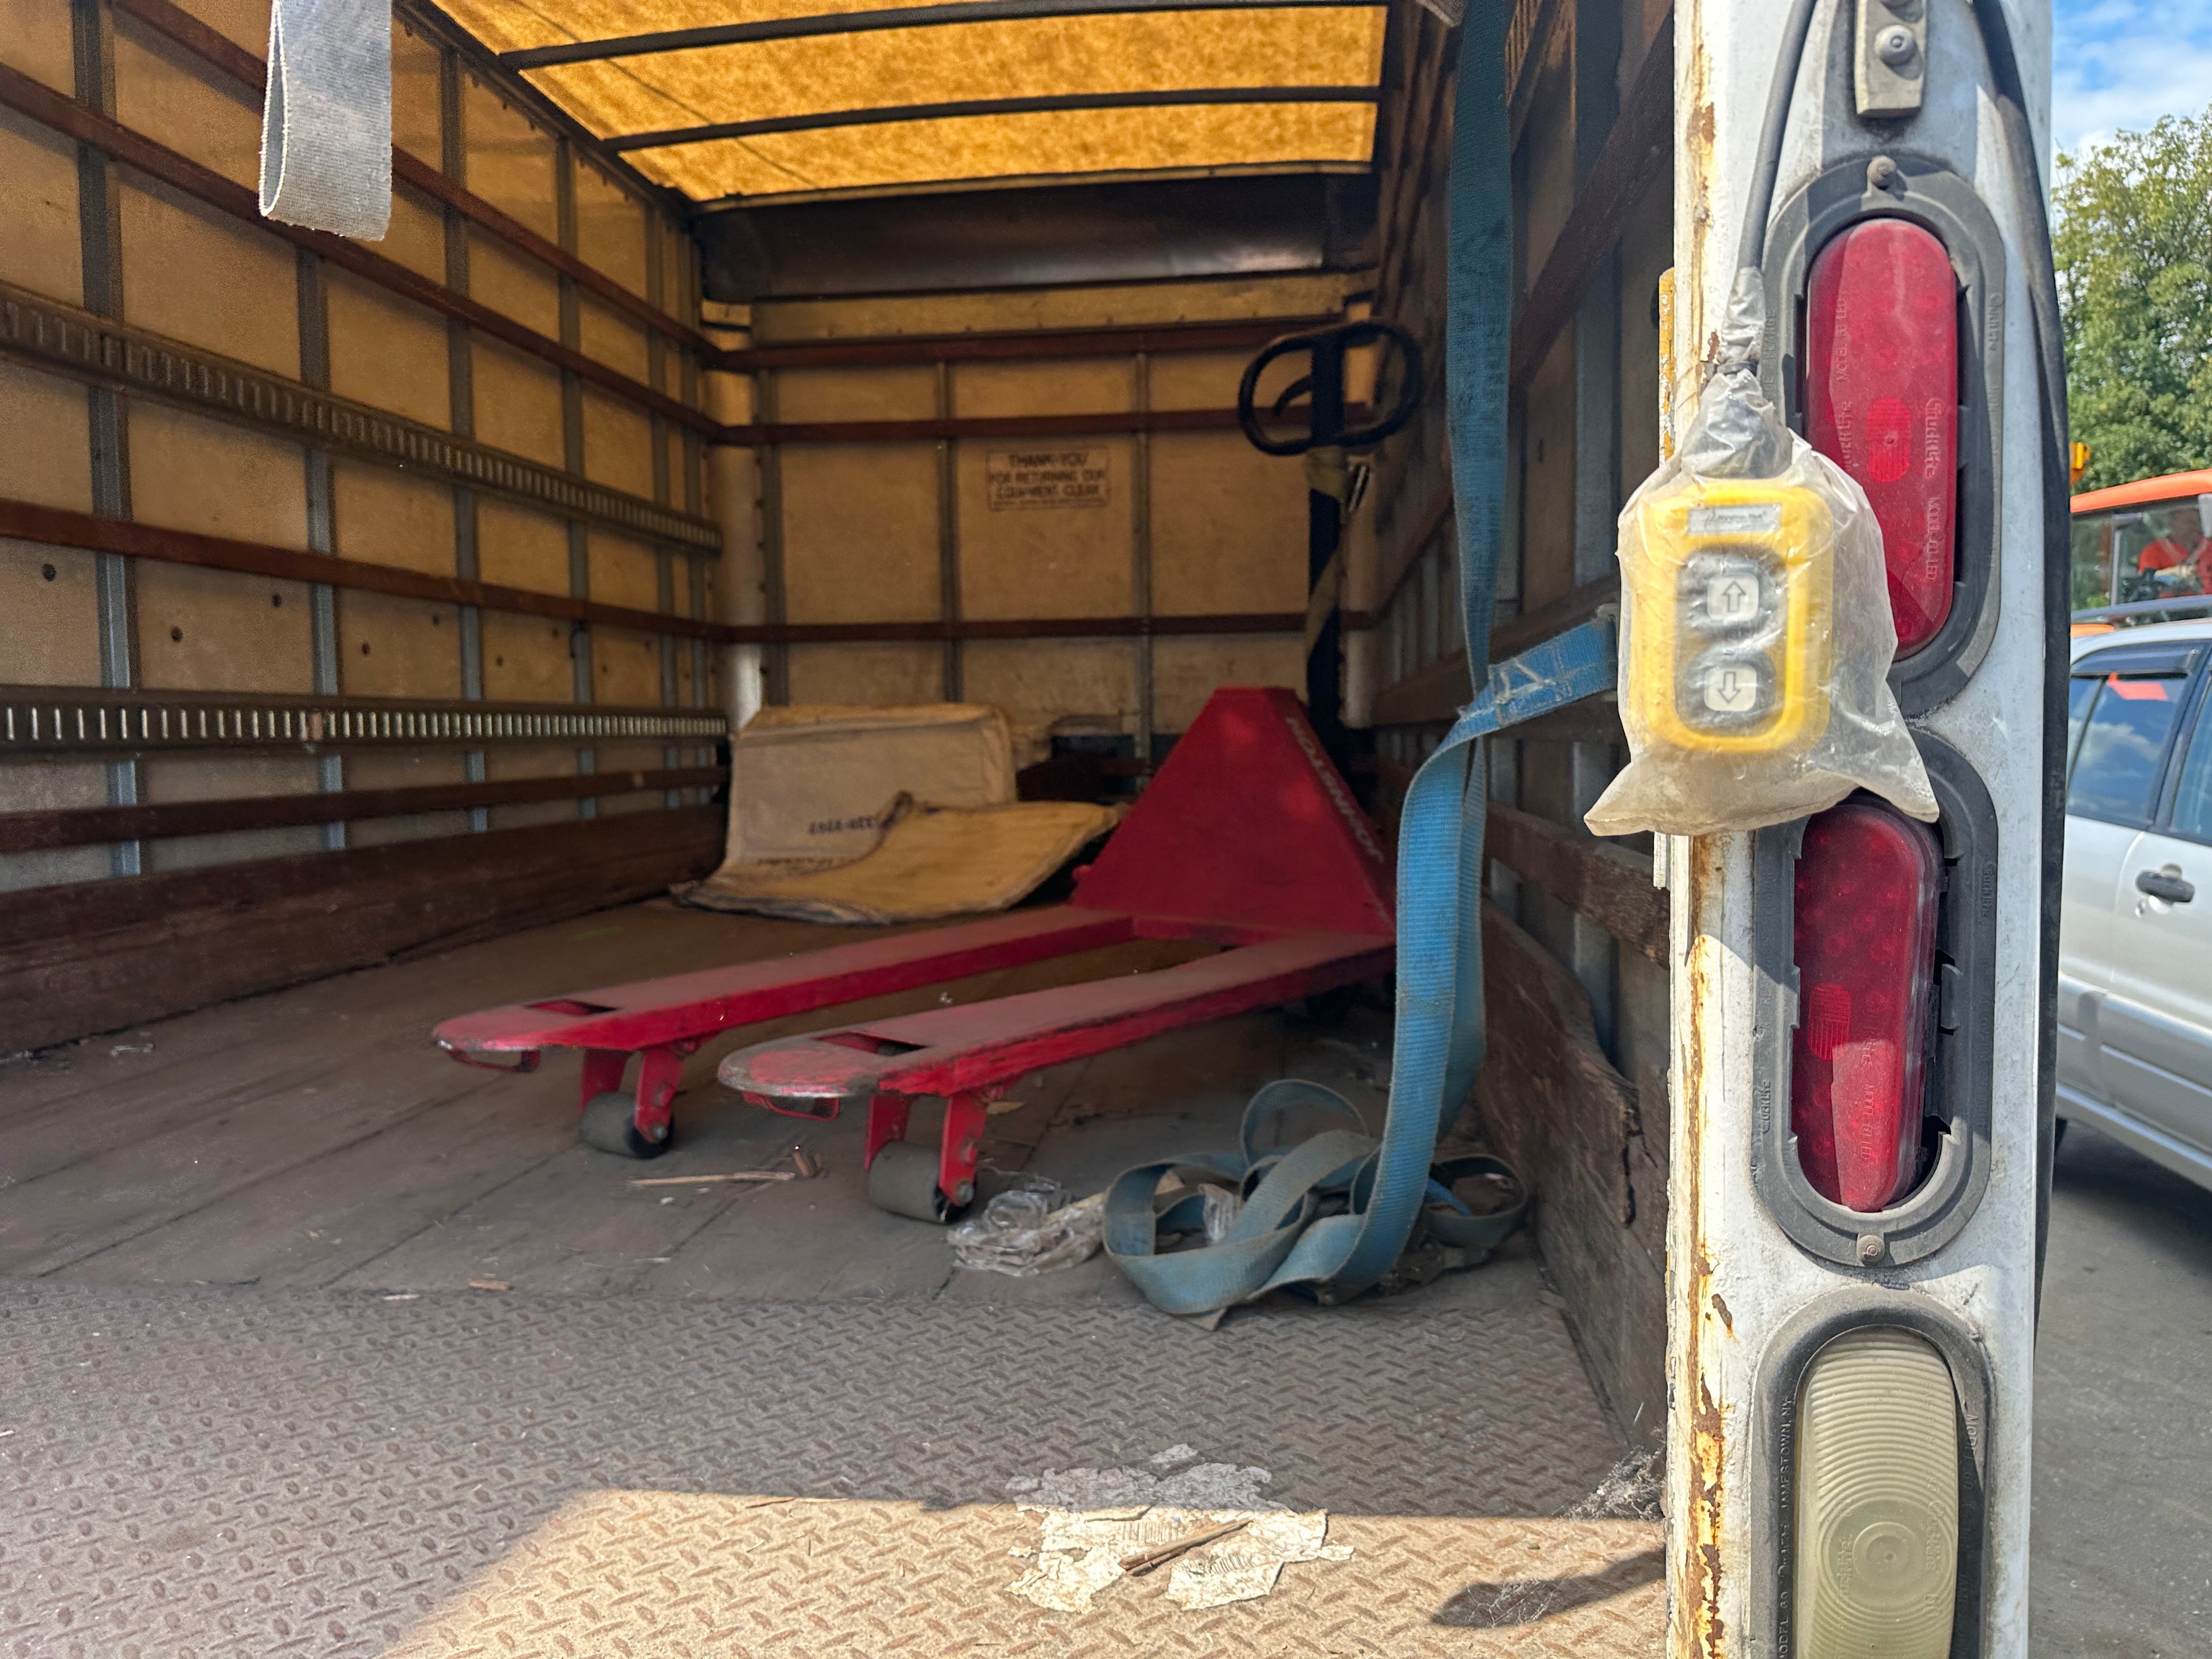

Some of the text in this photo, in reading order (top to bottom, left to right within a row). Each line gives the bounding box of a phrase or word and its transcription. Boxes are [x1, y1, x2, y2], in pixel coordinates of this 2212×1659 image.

[1838, 344, 1850, 381] MODEL
[1009, 453, 1088, 467] THANK YOU
[988, 469, 1105, 483] FOR RETURNING OUR
[997, 484, 1100, 499] EQUIPMENT CLEAN
[1927, 497, 1940, 535] MODEL
[1926, 559, 1938, 581] LED
[1864, 1084, 1875, 1116] MODEL
[1861, 1140, 1872, 1160] LED
[1782, 1397, 1793, 1416] NY
[1963, 1414, 1978, 1464] MODEL
